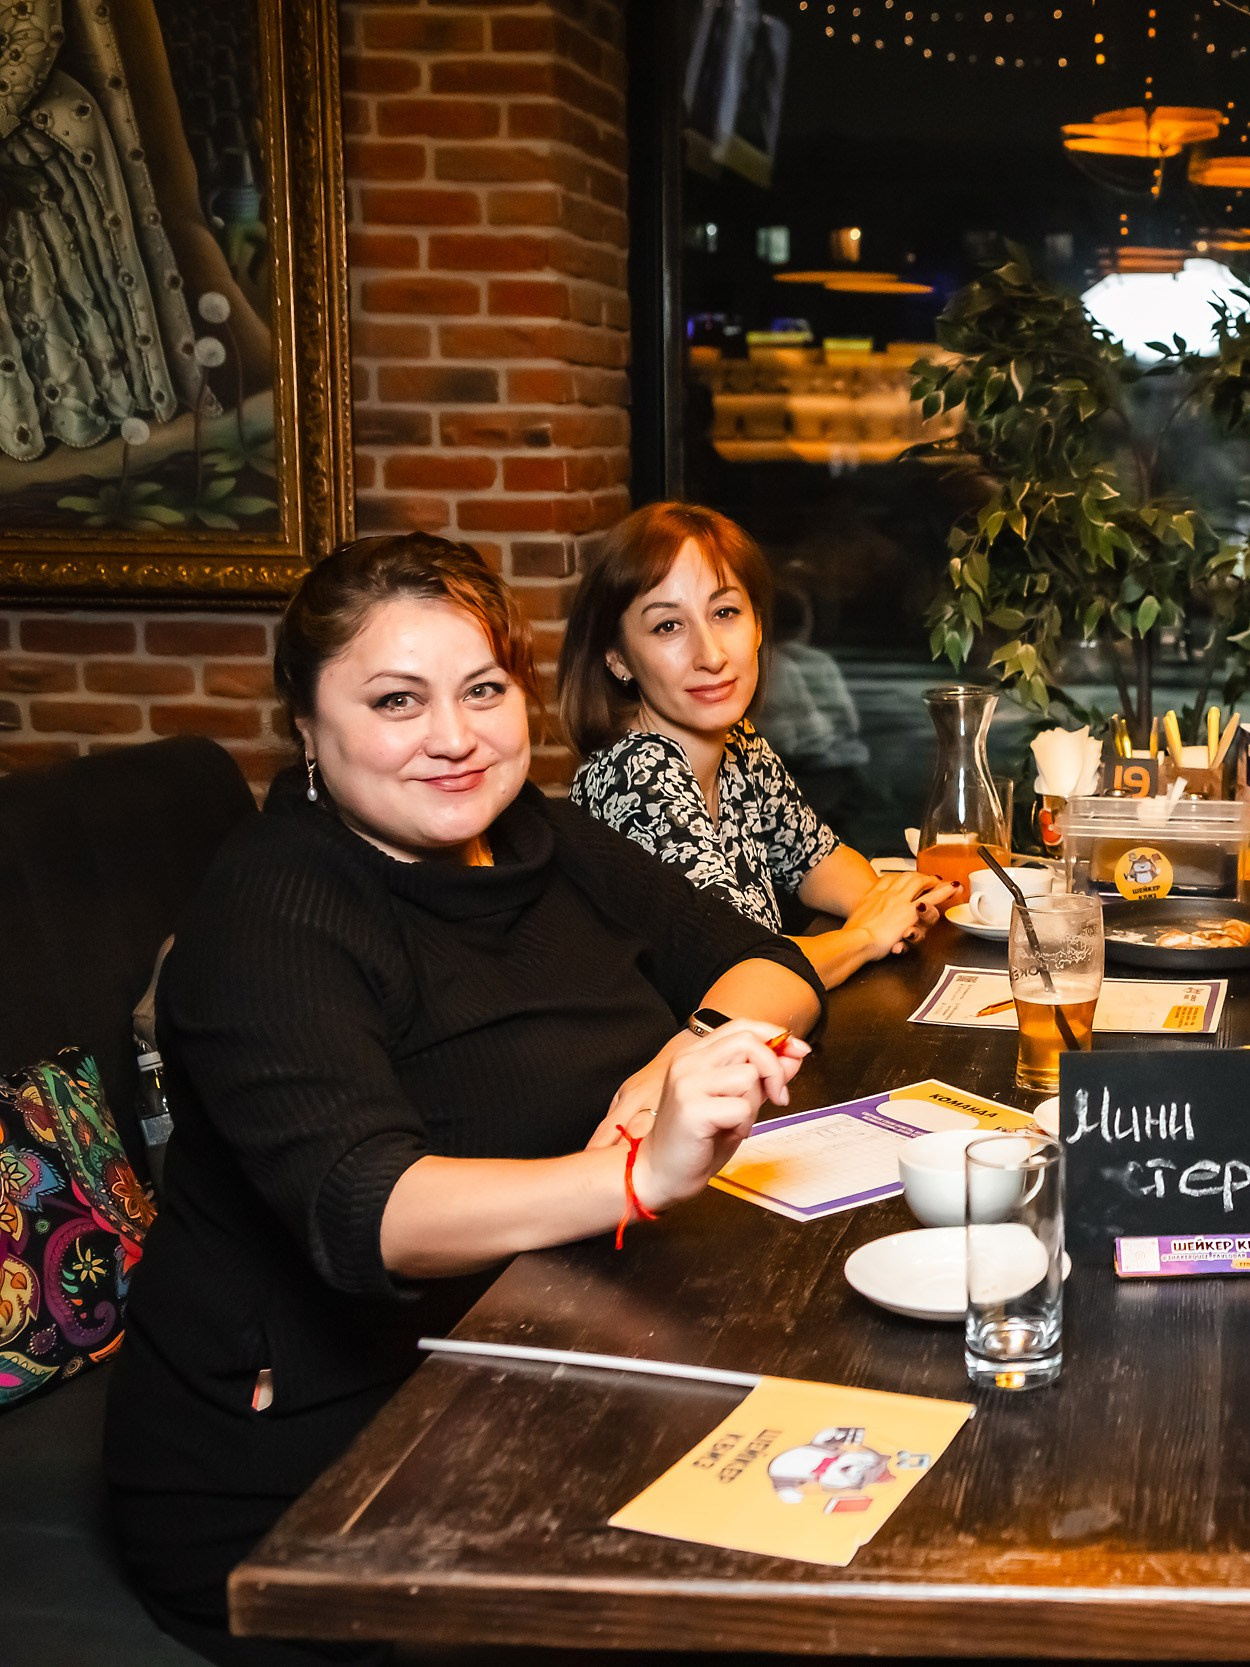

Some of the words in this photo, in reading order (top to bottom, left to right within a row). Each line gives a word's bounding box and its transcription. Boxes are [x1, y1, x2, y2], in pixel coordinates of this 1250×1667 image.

[1113, 765, 1151, 798] 19
[928, 1093, 999, 1118] КОМАНДА
[1066, 1086, 1195, 1144] Мини
[1173, 1238, 1232, 1251] ШЕЙКЕР
